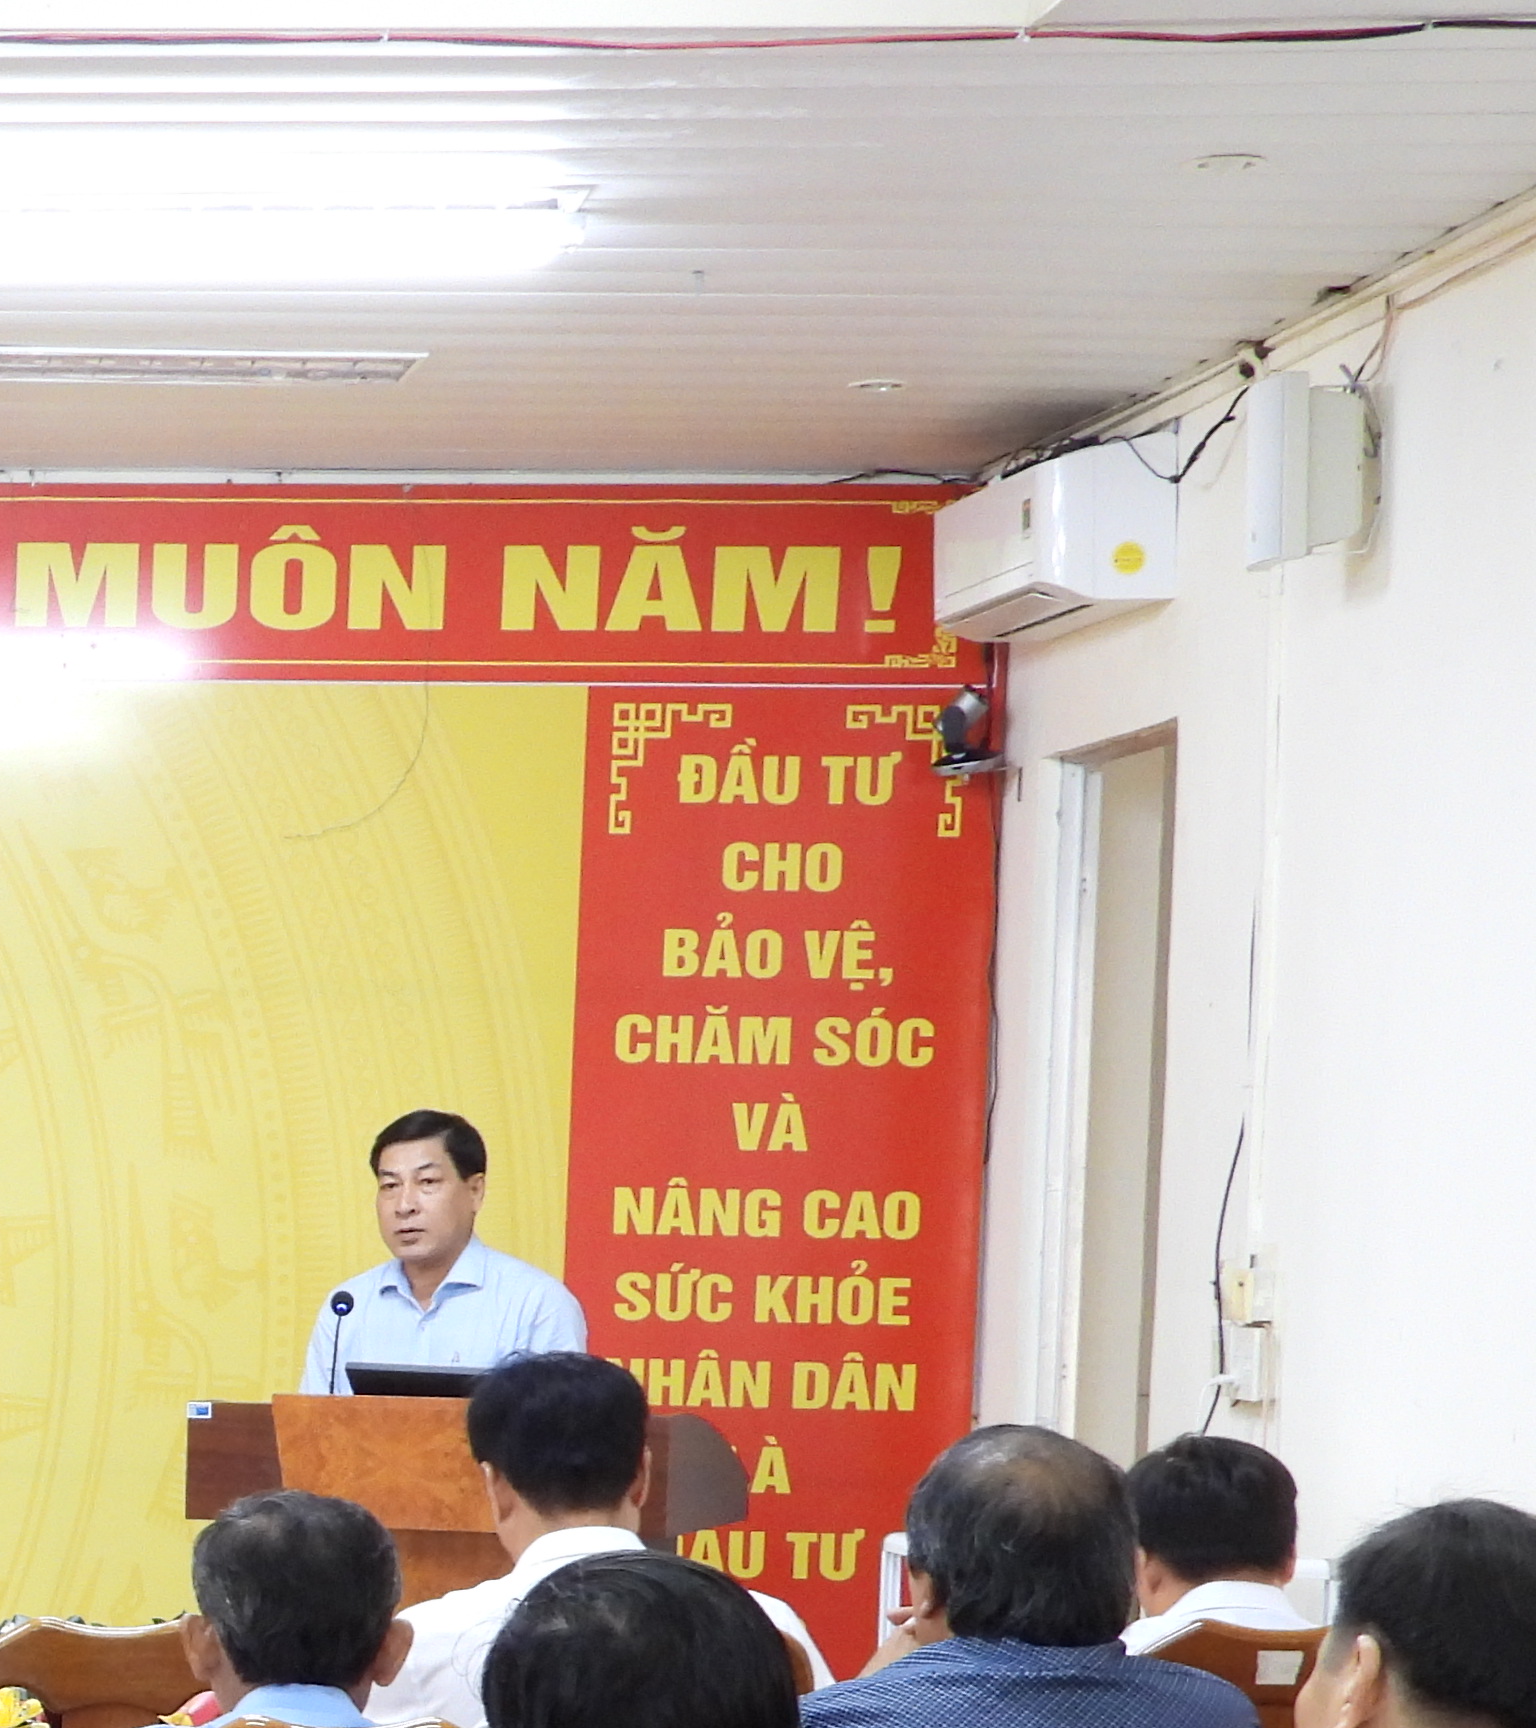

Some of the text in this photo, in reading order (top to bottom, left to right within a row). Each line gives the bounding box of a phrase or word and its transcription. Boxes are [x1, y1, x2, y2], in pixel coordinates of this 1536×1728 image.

[17, 524, 447, 631] MUÔN
[500, 525, 902, 633] NĂM!
[677, 737, 903, 807] ĐẦU TƯ
[721, 841, 843, 893] CHO
[662, 911, 893, 991] BẢO VỆ,
[614, 1004, 935, 1068] CHĂM SÓC
[732, 1092, 808, 1152] VÀ
[612, 1176, 921, 1240] NÂNG CAO
[613, 1259, 912, 1326] SỨC KHỎE
[605, 1347, 917, 1411] HÂN DÂN
[730, 1434, 792, 1495] À
[786, 1528, 865, 1581] TƯ
